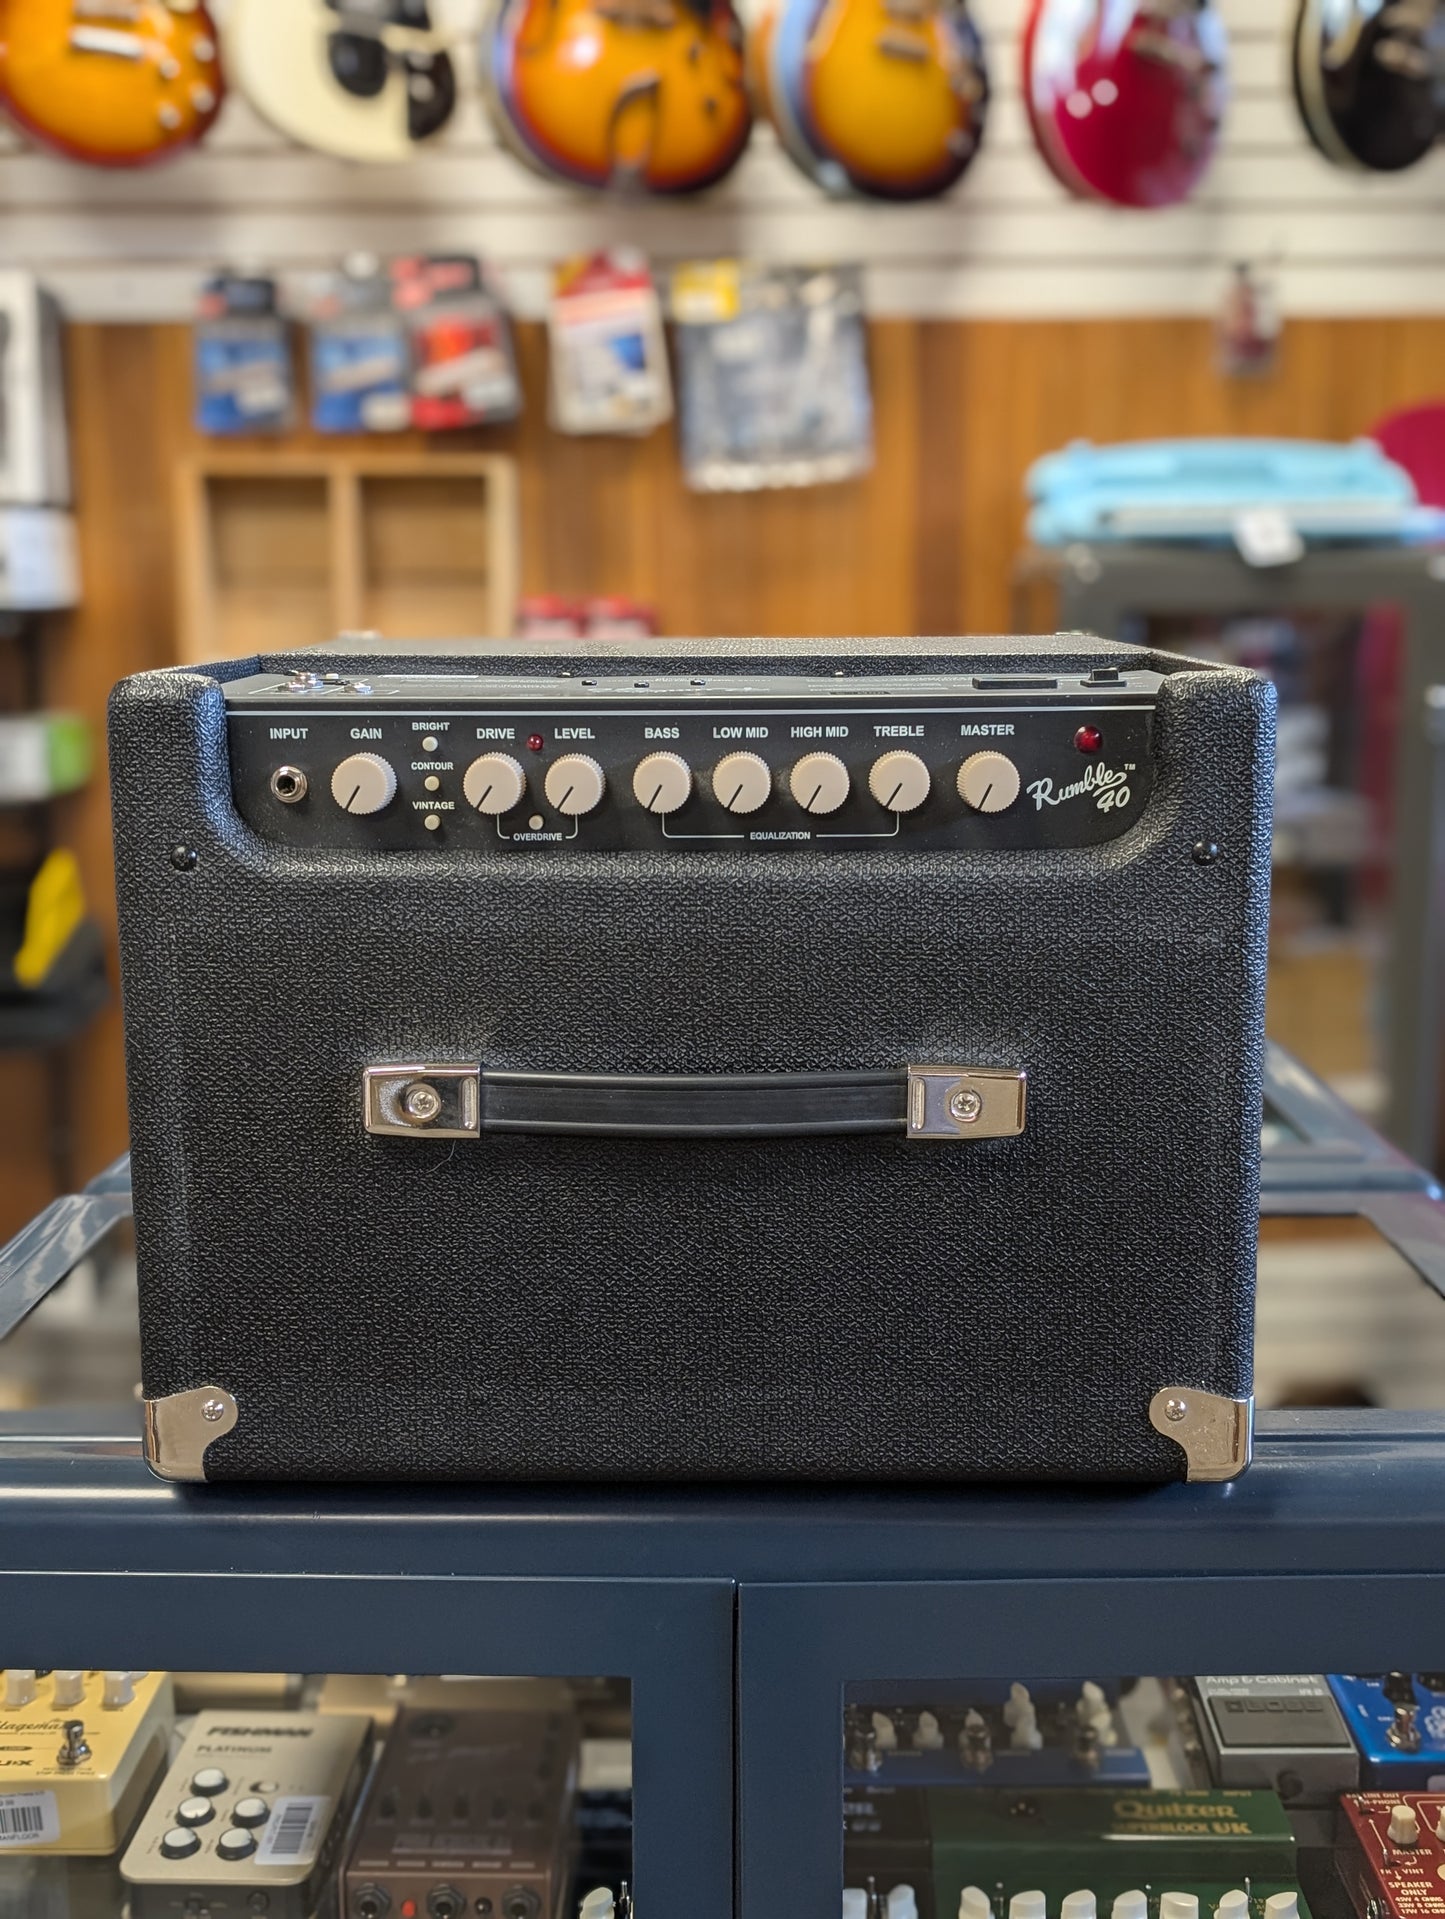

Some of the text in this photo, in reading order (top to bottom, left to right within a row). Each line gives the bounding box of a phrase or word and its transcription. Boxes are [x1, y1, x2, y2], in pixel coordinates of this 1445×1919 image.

[412, 722, 449, 731] BRIGHT
[790, 726, 849, 738] HIGH MID
[873, 726, 925, 737] TREBLE
[961, 725, 1015, 736] MASTER
[269, 728, 308, 739] INPUT
[350, 728, 382, 739] GAIN
[476, 728, 515, 739] DRIVE
[554, 728, 595, 739] LEVEL
[644, 727, 680, 739] BASS
[713, 727, 769, 738] LOW MID
[411, 762, 454, 770] CONTOUR
[1026, 761, 1128, 811] Rumble
[1096, 786, 1131, 813] 40
[412, 801, 455, 810] VINTAGE
[513, 832, 562, 842] OVERDRIVE
[750, 832, 811, 841] EQUALIZATION
[1388, 1881, 1434, 1889] SPEAKER
[1401, 1888, 1428, 1896] ONLY
